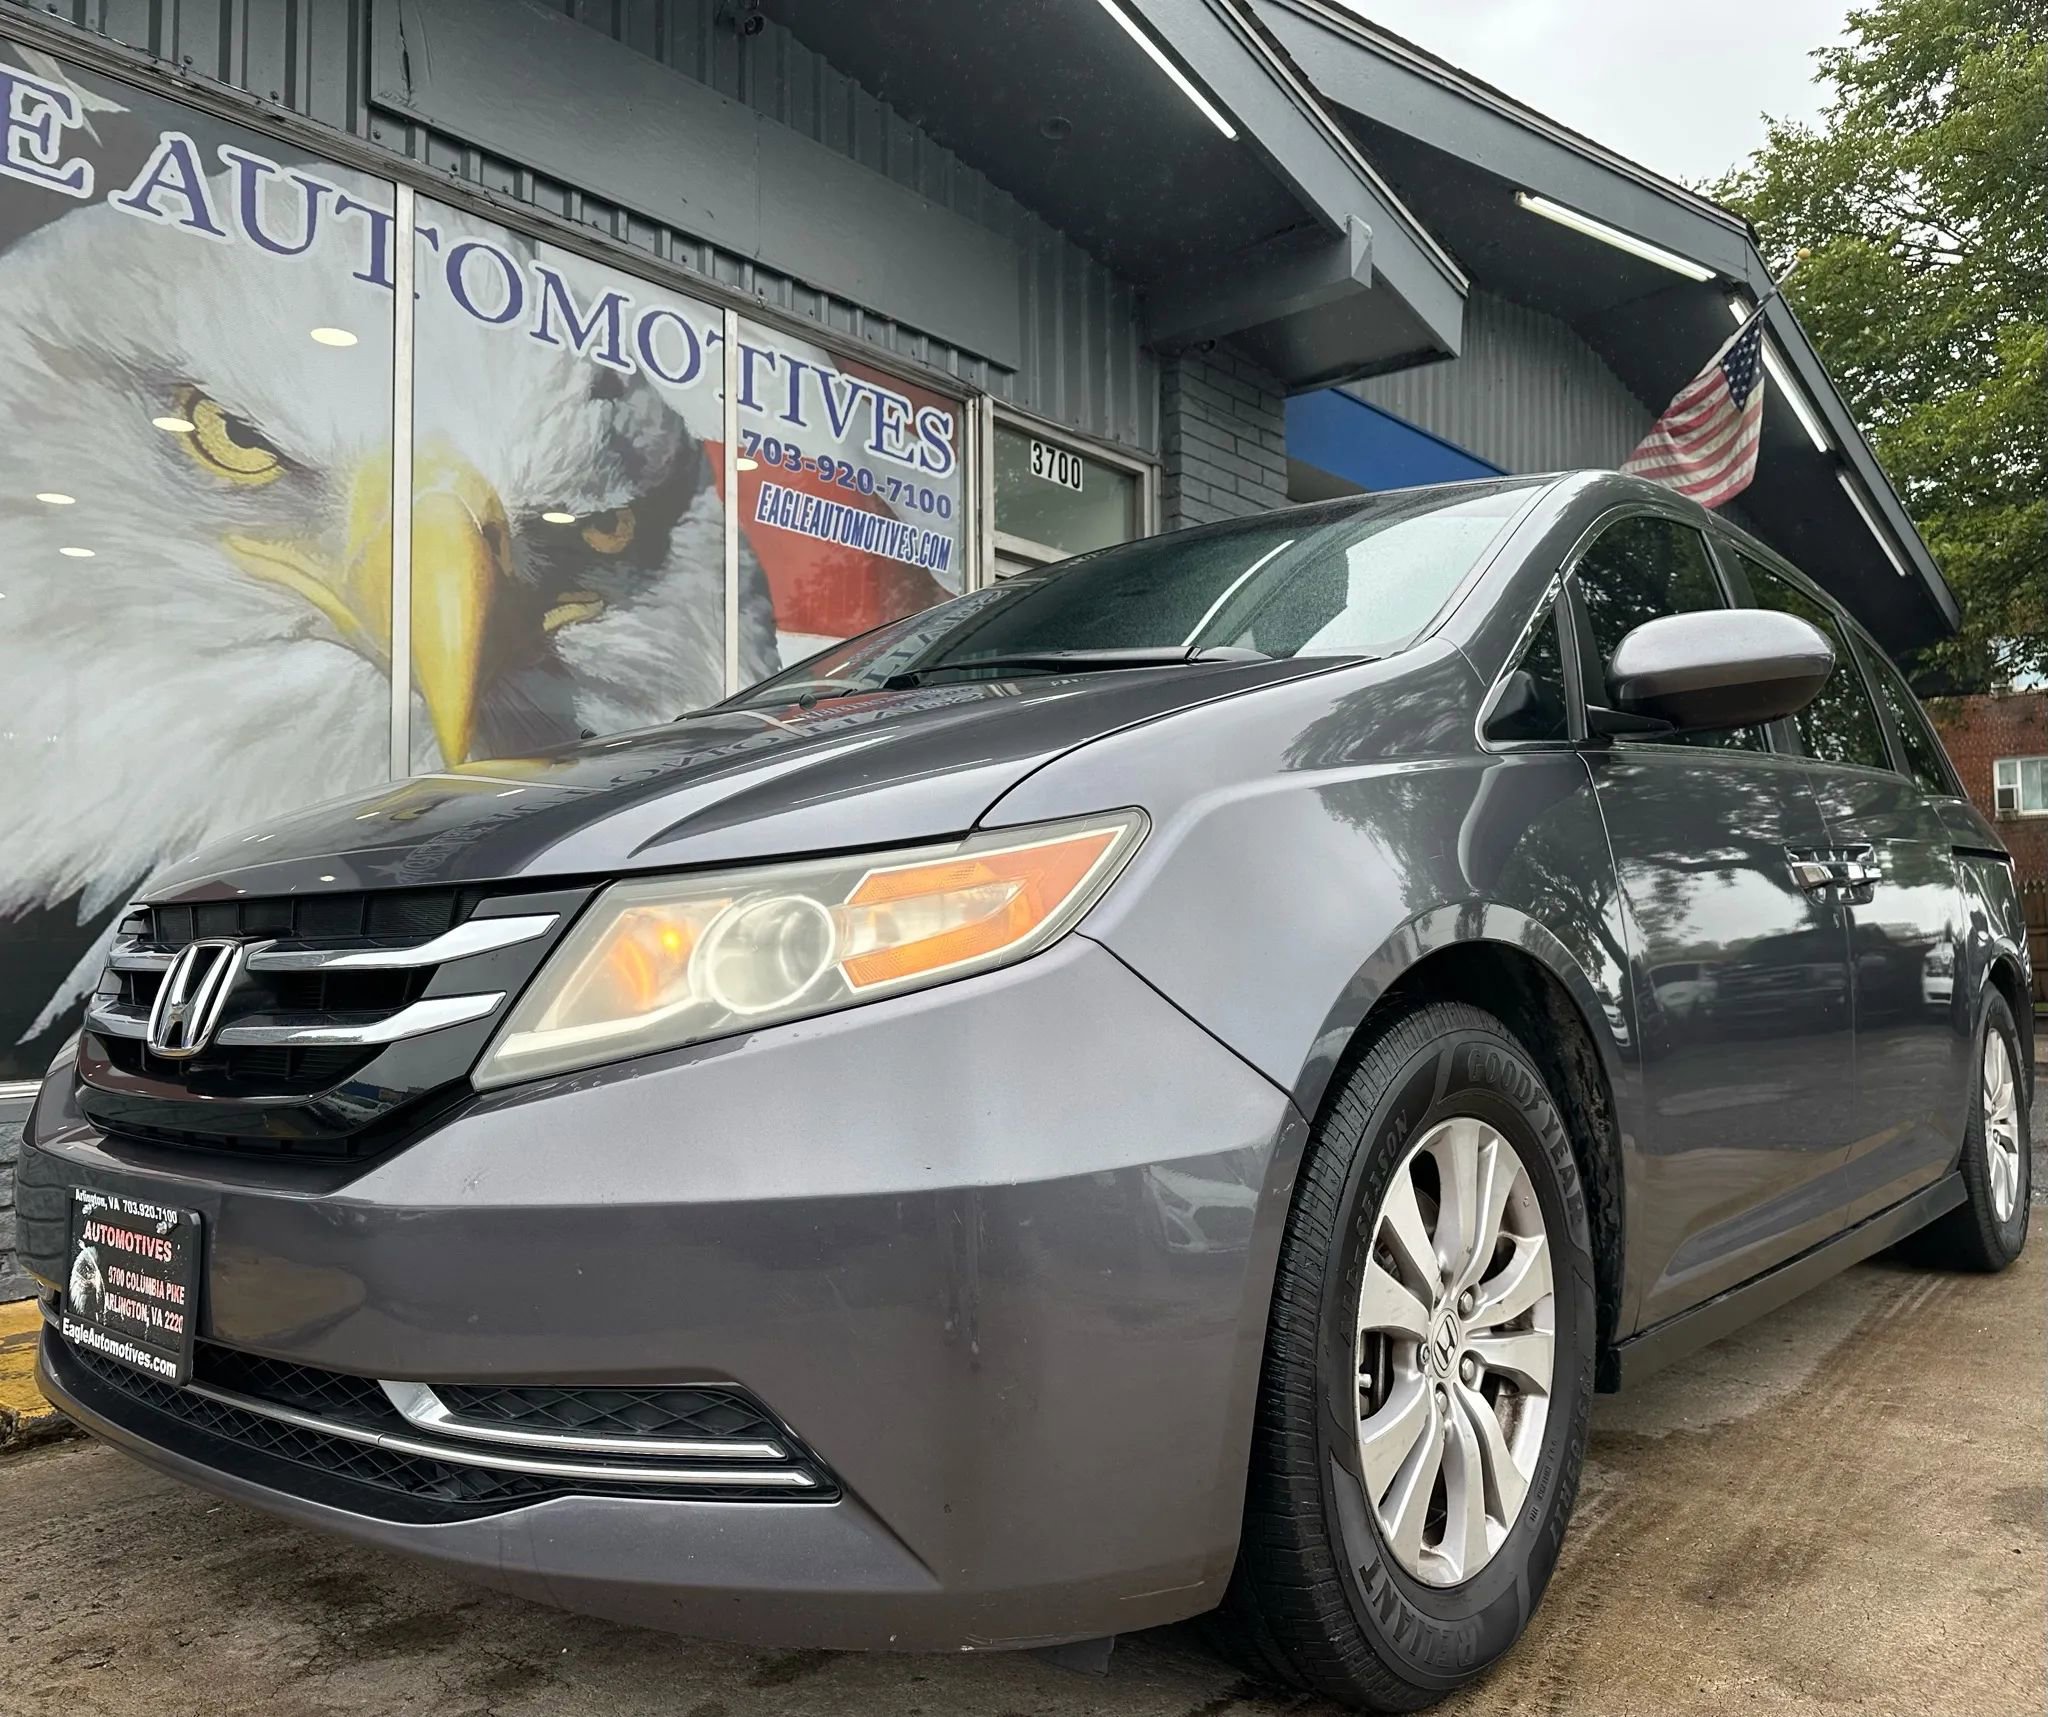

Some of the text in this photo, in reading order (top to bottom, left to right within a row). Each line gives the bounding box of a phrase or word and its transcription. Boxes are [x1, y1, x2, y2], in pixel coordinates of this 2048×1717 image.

[108, 130, 958, 478] AUTOMOTIVES
[741, 428, 953, 520] 703-920-7100
[1033, 442, 1081, 489] 3700
[755, 481, 954, 574] EAGLEAUTOMOTIVES.COM
[1467, 1048, 1587, 1227] GOODYEAR
[75, 1188, 177, 1223] Arlington, VA 703.920.7100
[83, 1221, 172, 1262] AUTOMOTIVES
[104, 1291, 150, 1327] ARLINGTON,
[150, 1306, 163, 1328] VA
[125, 1270, 165, 1300] COLUMBIA
[166, 1282, 185, 1306] PIKE
[62, 1317, 177, 1379] EagleAutomotives.com
[1358, 1556, 1479, 1668] RELIANT
